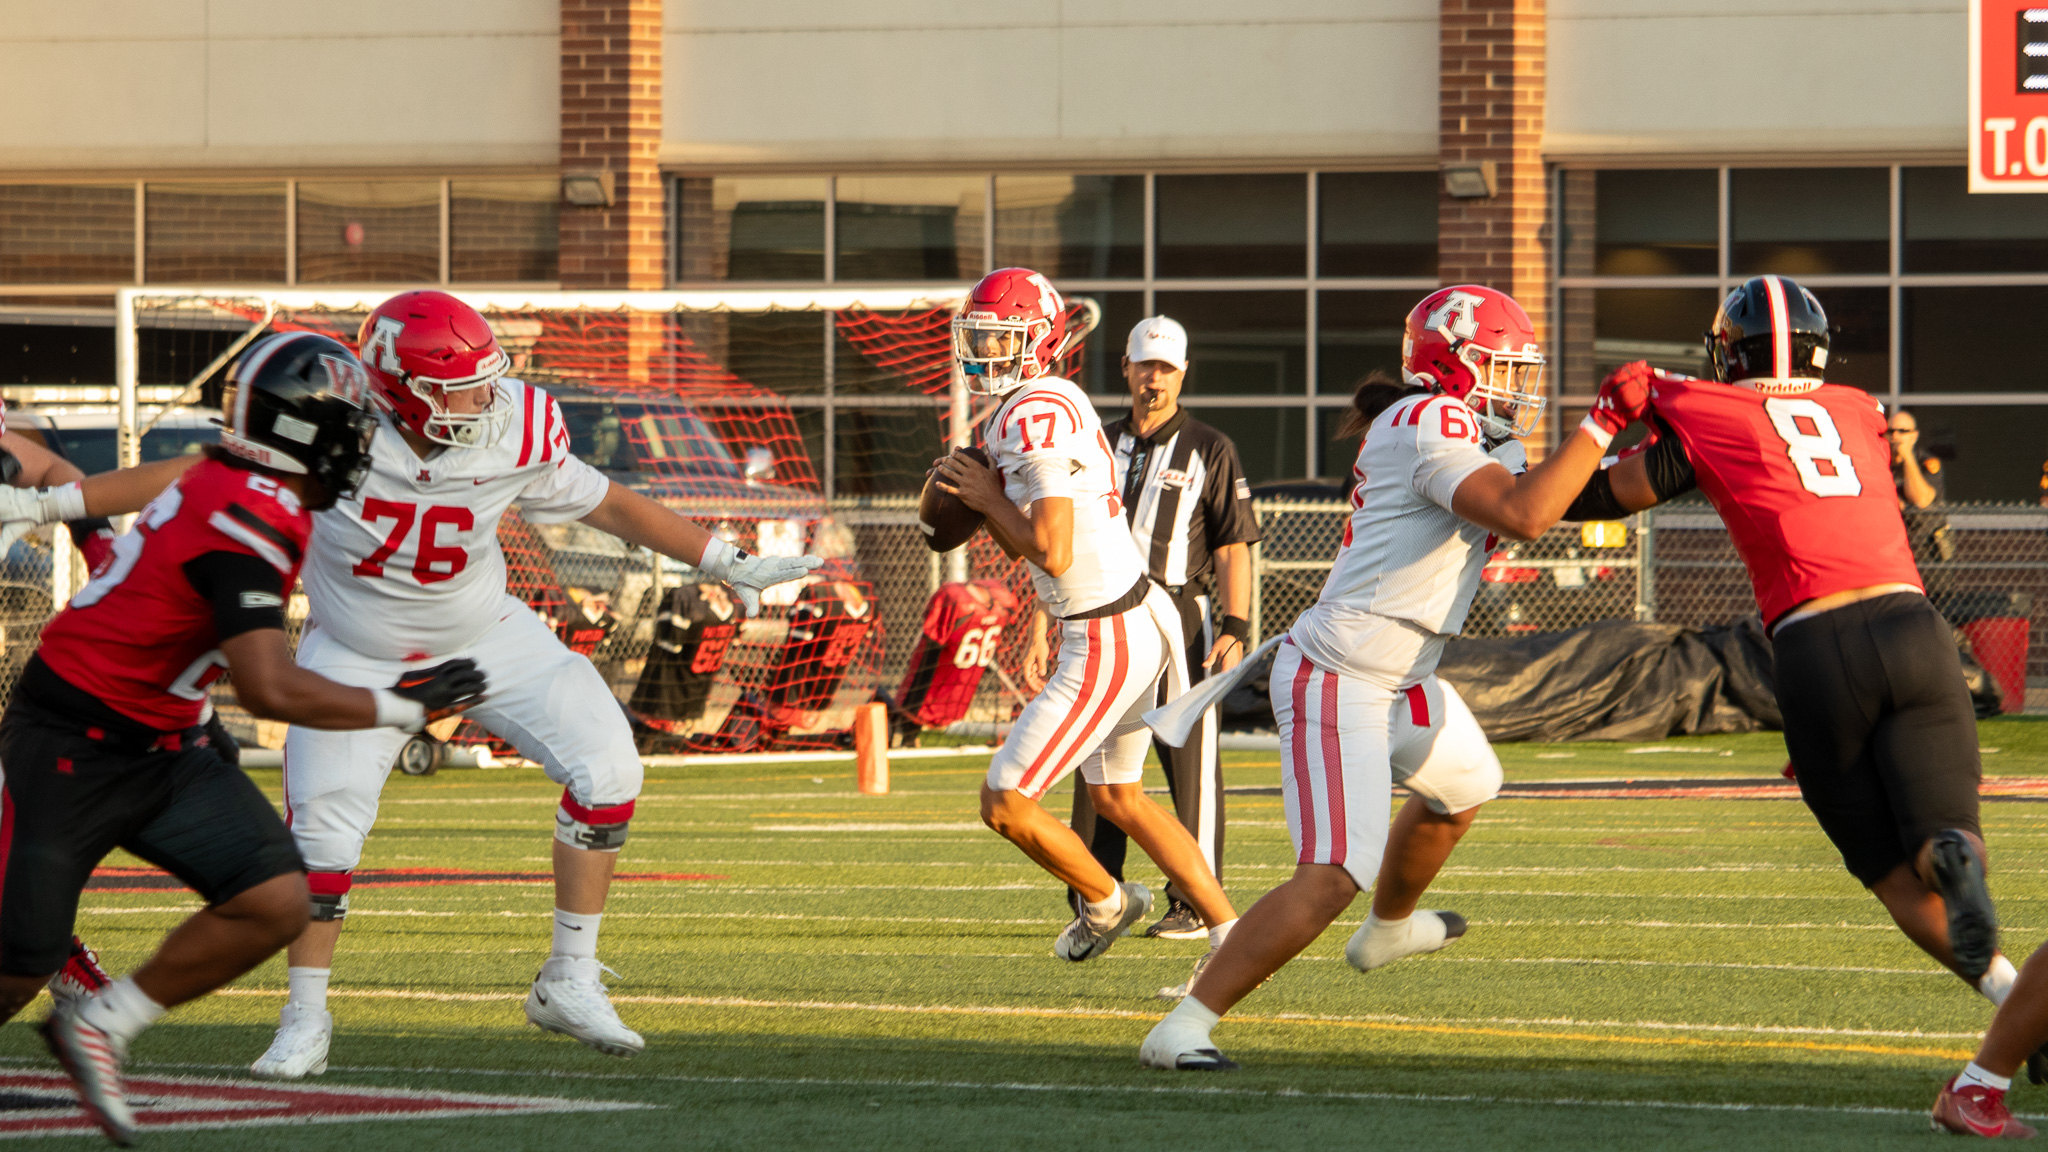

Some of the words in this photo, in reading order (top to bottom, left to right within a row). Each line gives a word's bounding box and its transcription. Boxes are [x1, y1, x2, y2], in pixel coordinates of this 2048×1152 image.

[1025, 273, 1065, 316] A
[1424, 290, 1486, 341] A
[362, 315, 405, 376] A
[318, 353, 369, 411] W
[222, 437, 272, 465] ddell
[1017, 411, 1056, 453] 17
[1763, 397, 1862, 498] 8
[352, 496, 475, 586] 76
[954, 625, 1002, 669] 66
